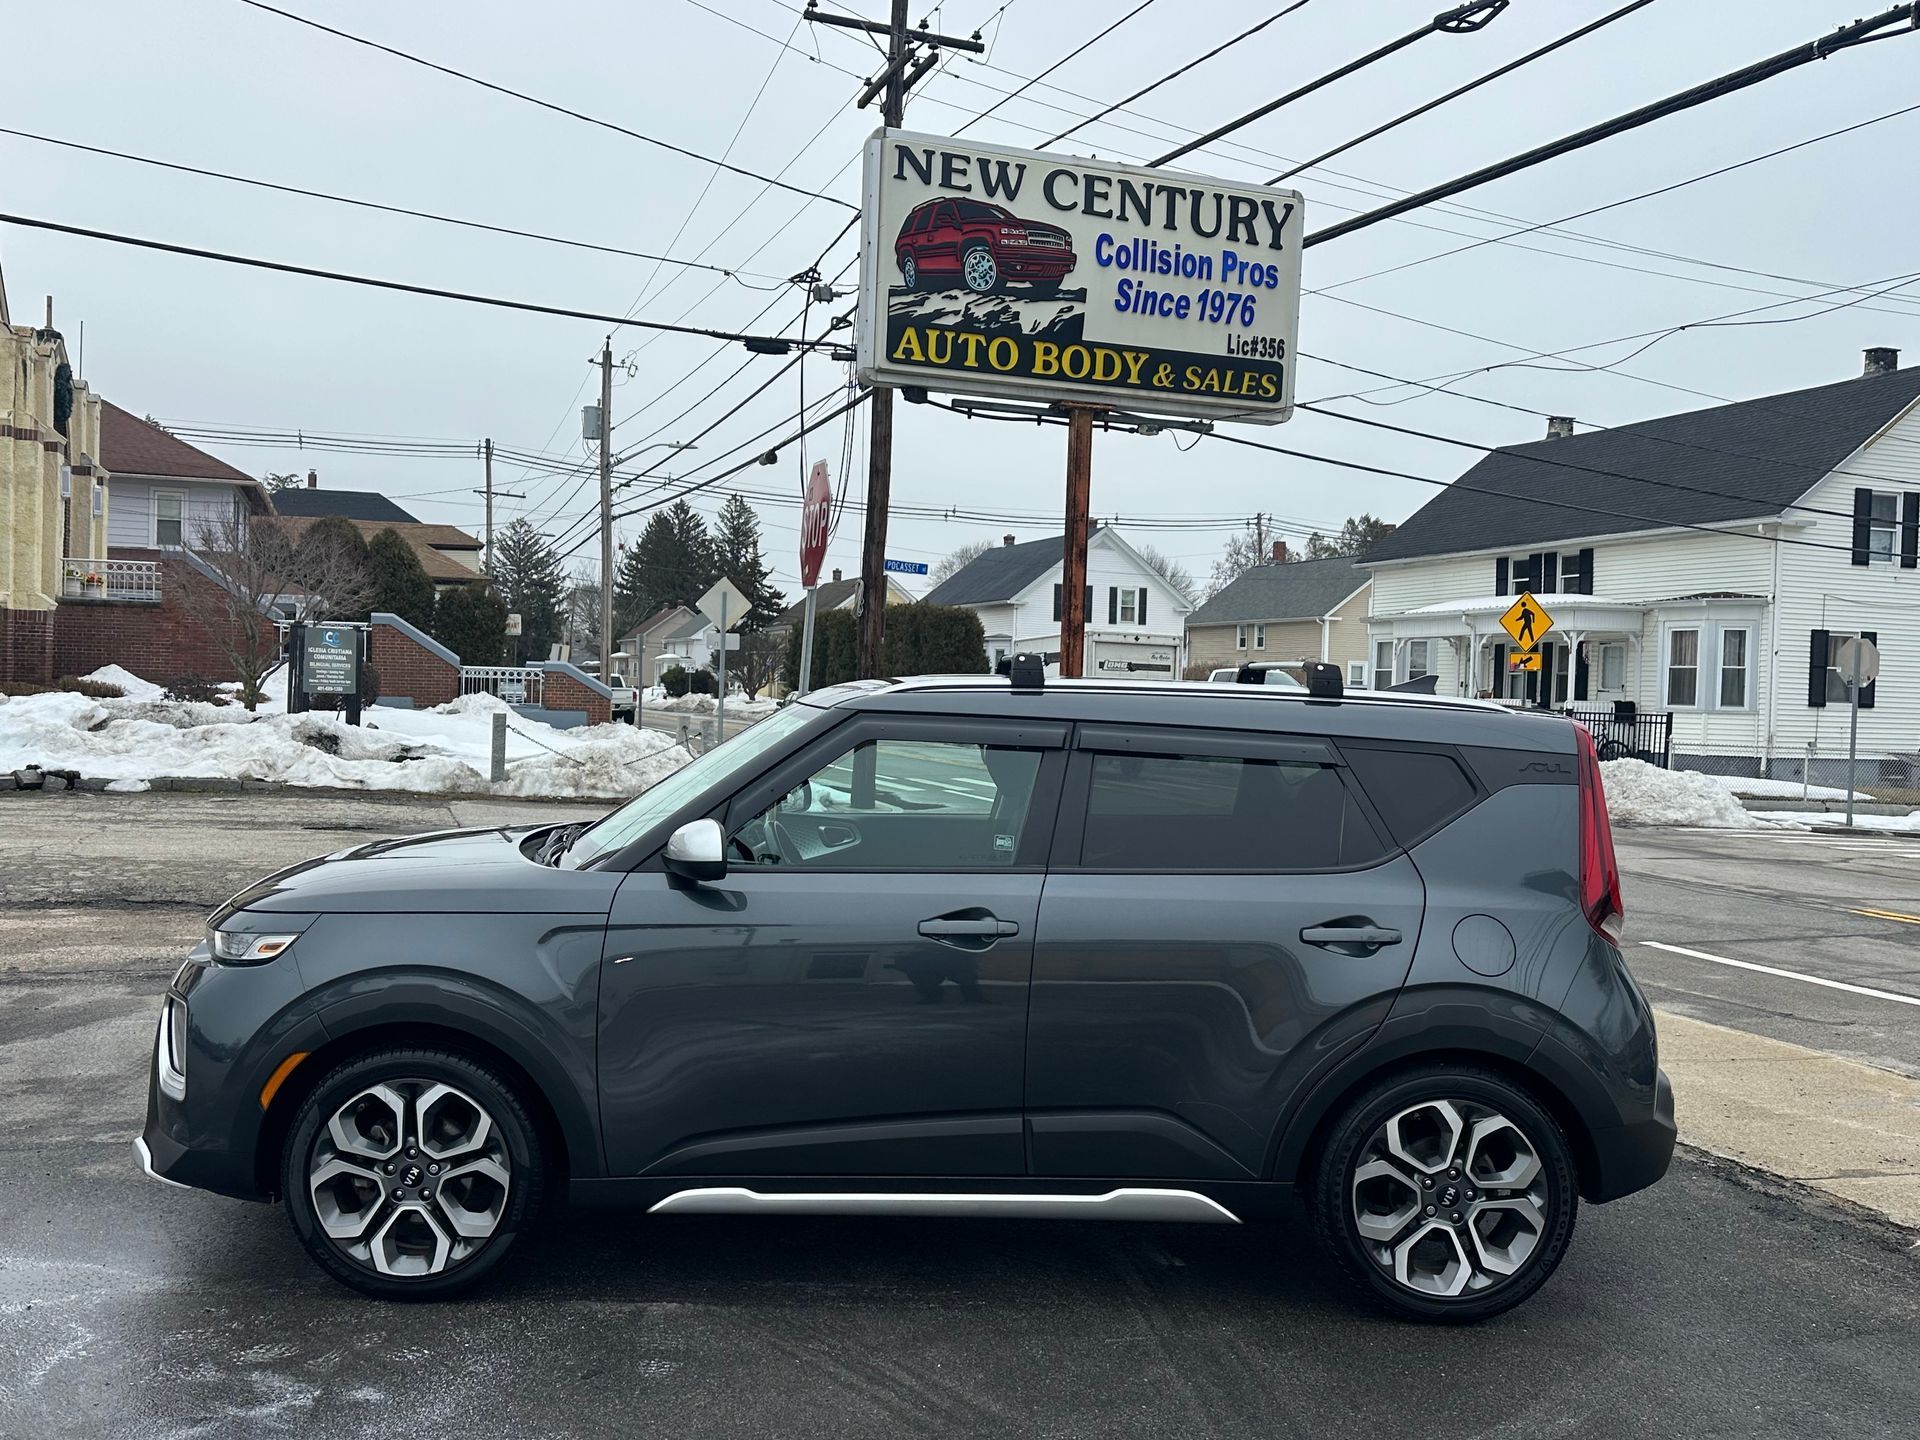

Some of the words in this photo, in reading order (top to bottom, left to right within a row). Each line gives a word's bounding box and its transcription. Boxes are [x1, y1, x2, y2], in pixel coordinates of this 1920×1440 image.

[893, 144, 1027, 201] NEW
[1043, 168, 1295, 250] CENTURY
[1095, 233, 1213, 281] Collision
[1221, 250, 1279, 289] Pros
[1114, 278, 1191, 320] Since
[1197, 288, 1257, 327] 1976
[892, 326, 1019, 371] AUTO
[1031, 341, 1150, 385] BODY
[1153, 363, 1175, 388] &
[1183, 366, 1278, 398] SALES
[1226, 333, 1286, 360] Lic#356
[802, 501, 828, 549] STOP
[887, 560, 920, 573] POCASSET
[404, 1166, 420, 1185] KIA
[1441, 1187, 1456, 1205] KIA
